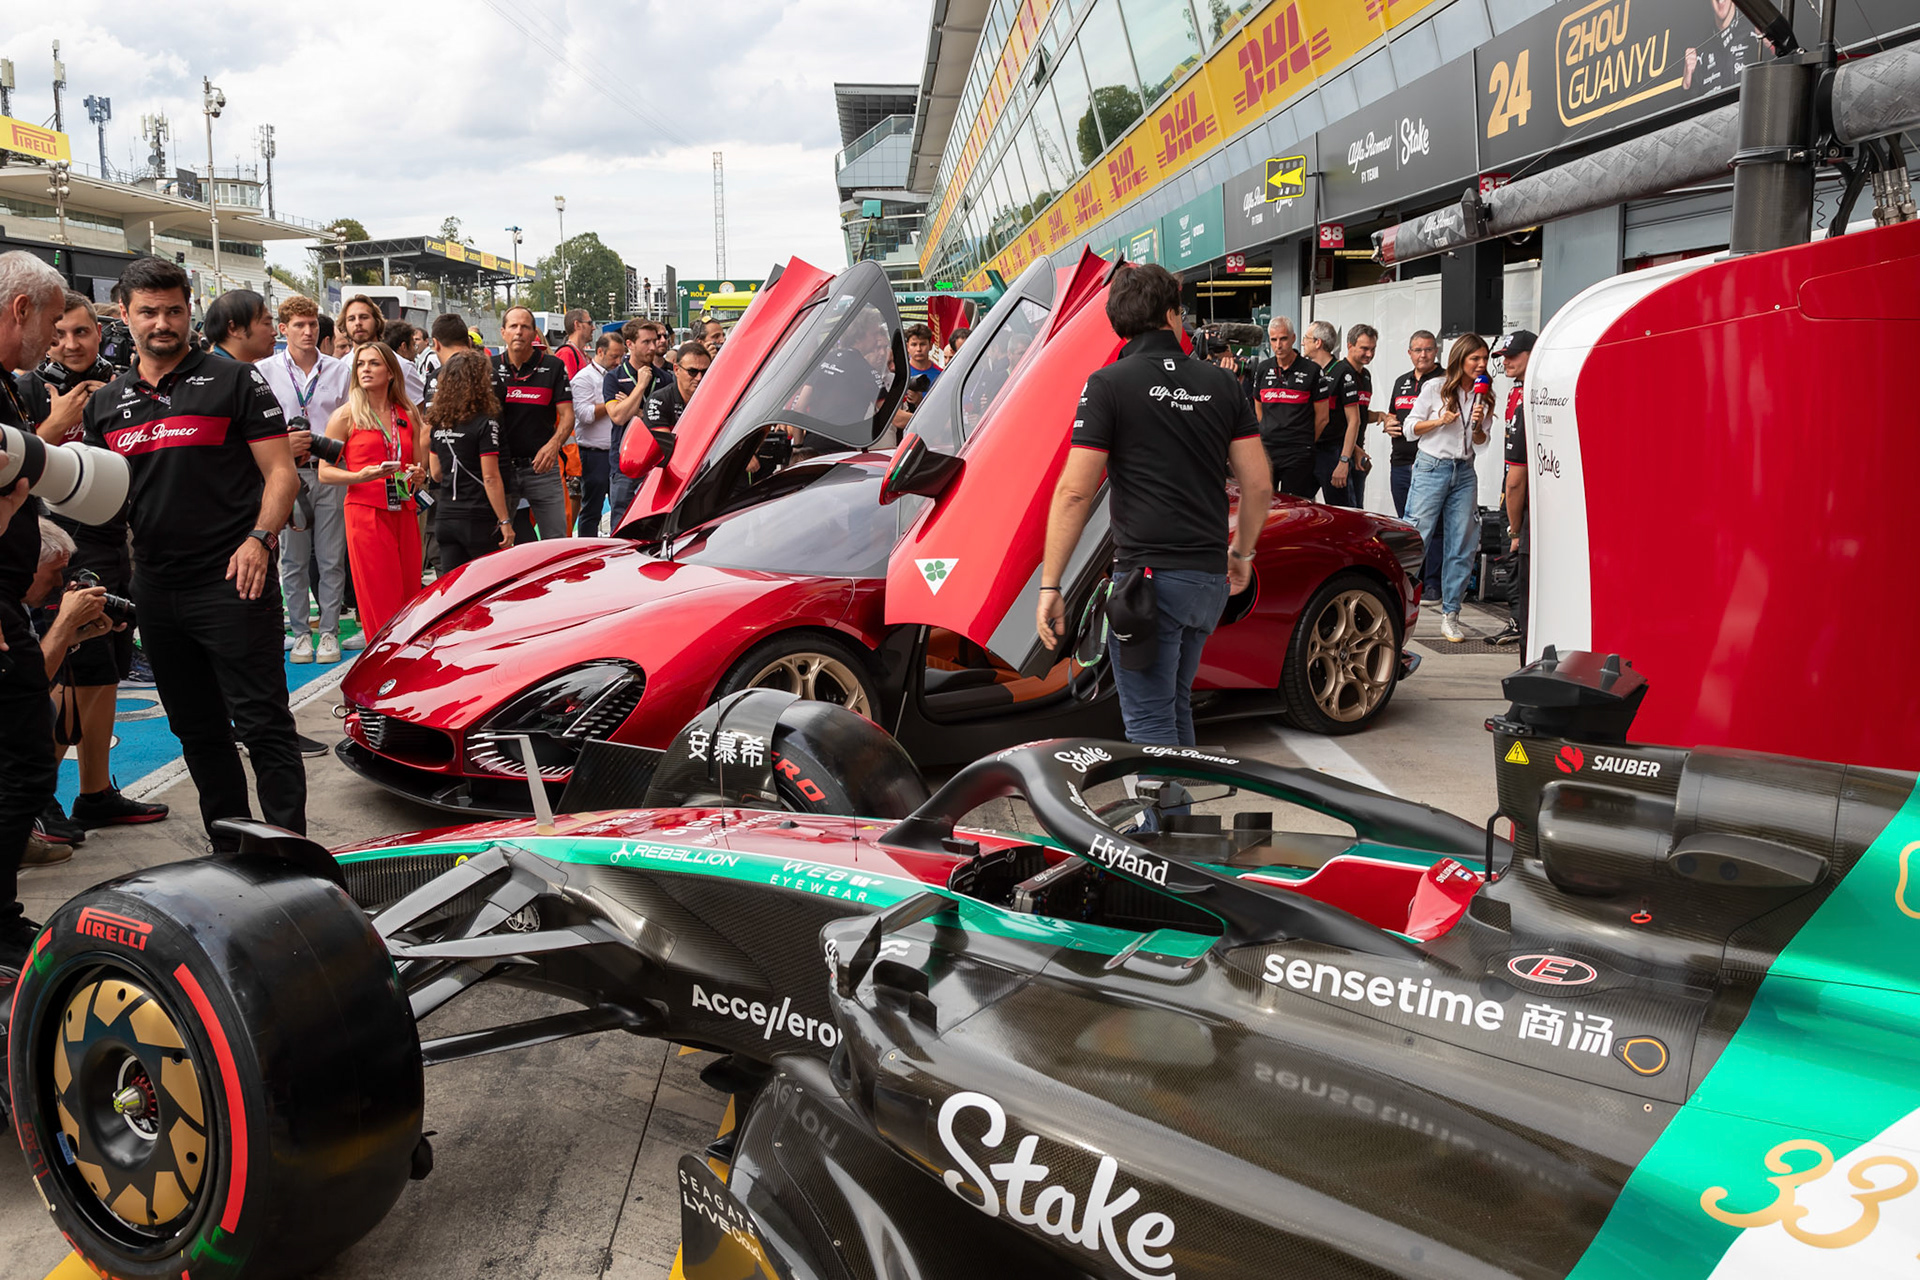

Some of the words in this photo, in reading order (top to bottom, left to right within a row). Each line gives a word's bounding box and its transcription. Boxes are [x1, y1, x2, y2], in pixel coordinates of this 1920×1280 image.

[1566, 0, 1630, 67] ZHOU
[1238, 1, 1312, 110] DHL
[1568, 29, 1669, 110] GUANYU
[1487, 49, 1532, 139] 24
[11, 124, 57, 156] PIRELLI
[1159, 91, 1206, 164] DHL
[1401, 118, 1430, 165] Stake
[1108, 145, 1142, 199] DHL
[1348, 139, 1364, 174] Alfa
[1364, 131, 1392, 158] Romeo
[1367, 166, 1379, 182] TEAM
[1480, 177, 1509, 196] 3
[1321, 226, 1343, 241] 38
[1227, 255, 1245, 267] 39
[1150, 386, 1173, 401] Alfa
[1173, 388, 1211, 402] Romeo
[1540, 387, 1568, 407] Romeo
[117, 431, 150, 452] Alfa
[150, 423, 198, 441] Romeo
[1537, 443, 1560, 478] Stake
[688, 729, 765, 768] 安慕希
[1054, 745, 1113, 774] Stake
[1142, 745, 1179, 758] Alfa
[1178, 749, 1240, 766] Romeo
[1591, 755, 1661, 778] SAUBER
[782, 861, 848, 882] WEB
[1087, 834, 1169, 886] Hyland
[770, 874, 868, 902] EYEWEAR
[76, 907, 153, 951] PIRELLI
[1262, 952, 1505, 1031] sensetime
[1517, 1002, 1614, 1058] 商汤
[679, 1169, 756, 1240] SEAGATE
[938, 1092, 1177, 1280] Stake
[1700, 1139, 1918, 1250] 33
